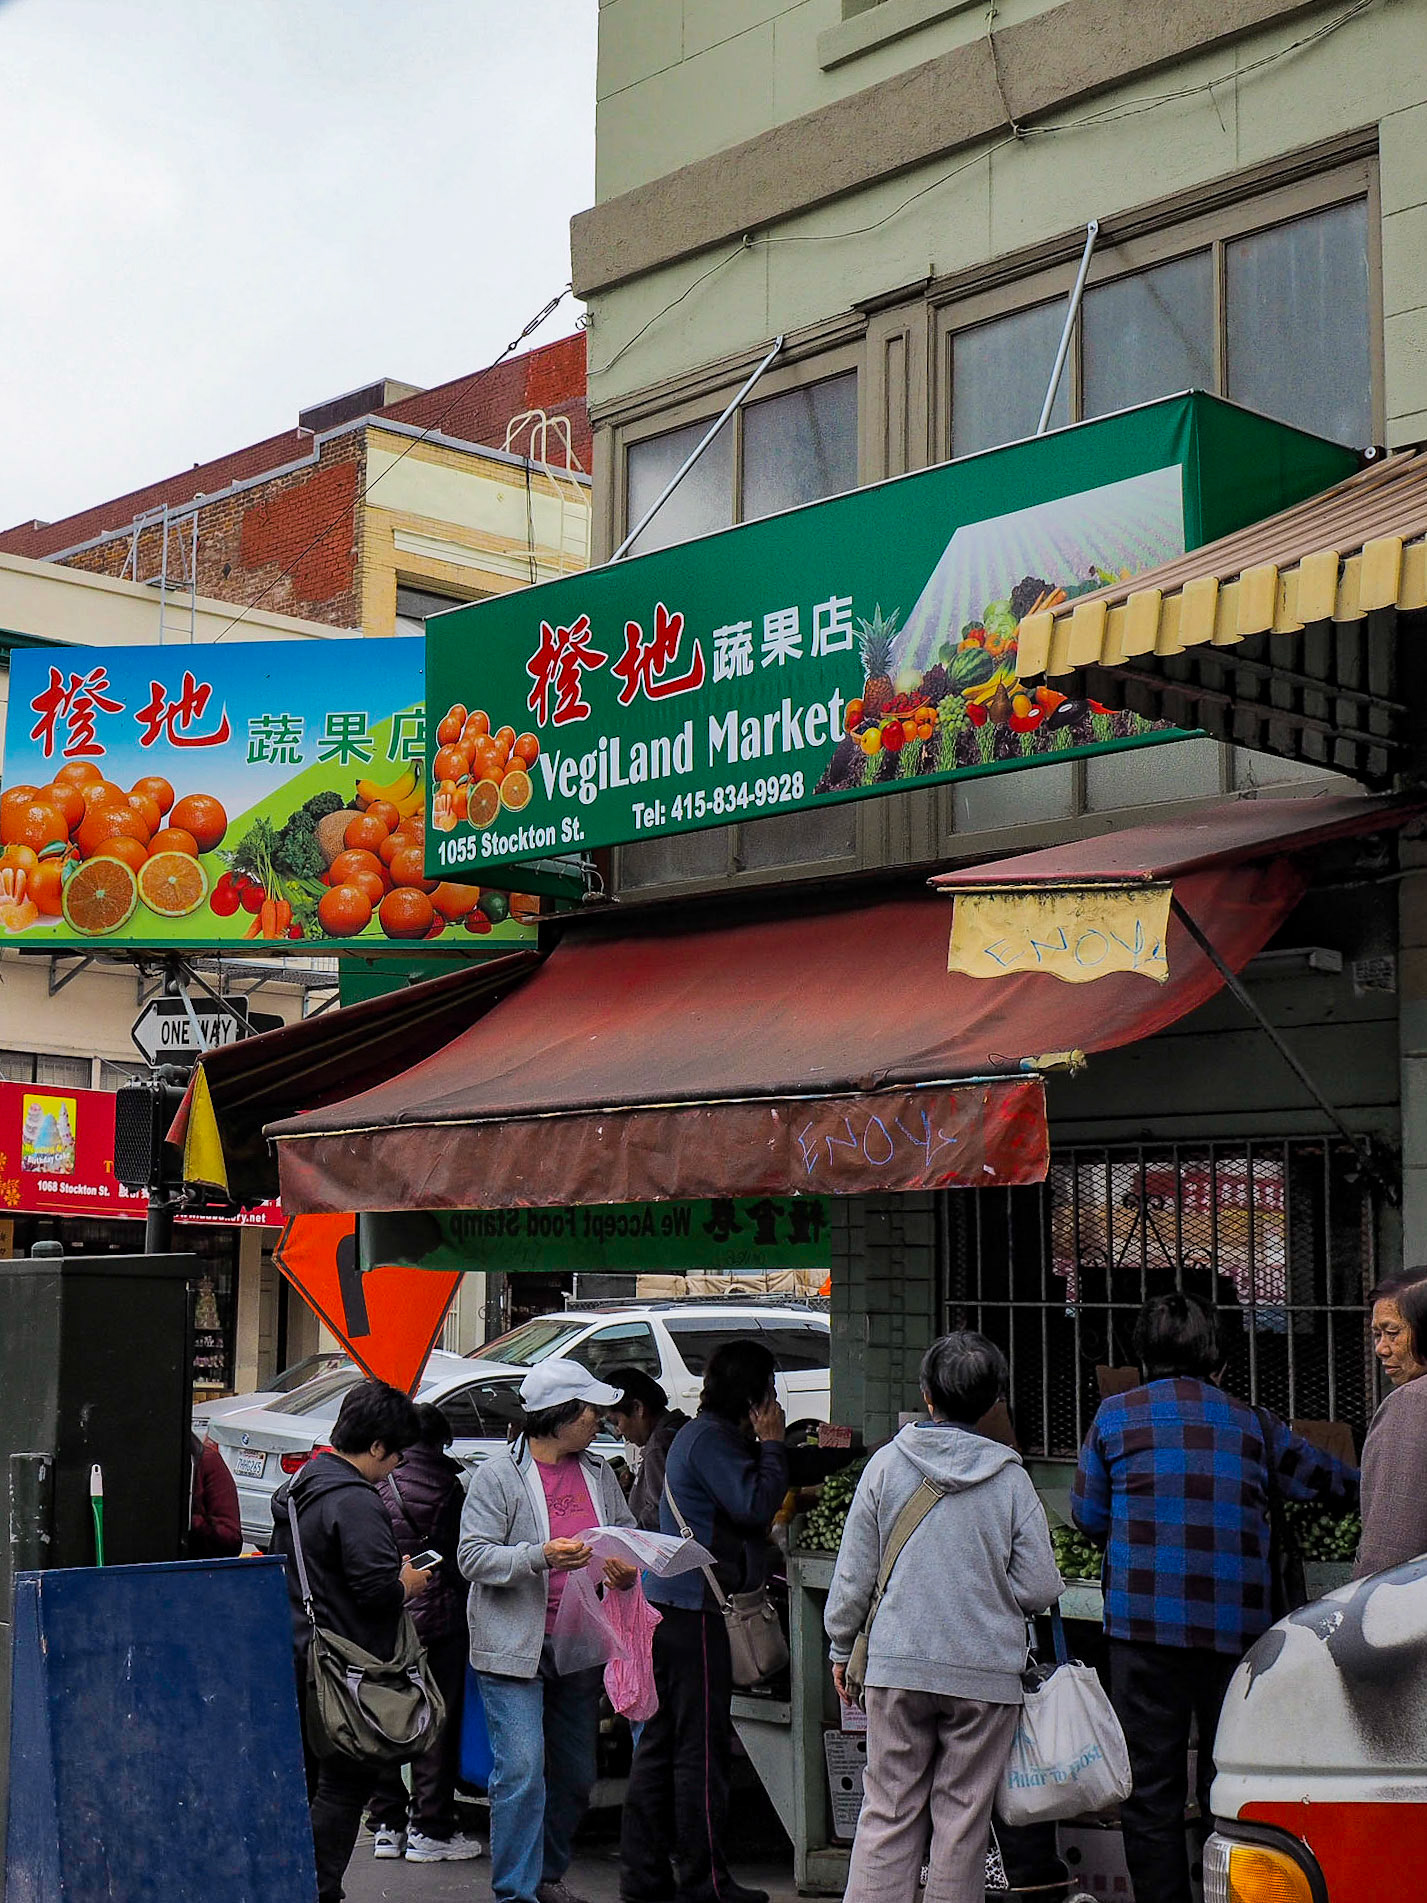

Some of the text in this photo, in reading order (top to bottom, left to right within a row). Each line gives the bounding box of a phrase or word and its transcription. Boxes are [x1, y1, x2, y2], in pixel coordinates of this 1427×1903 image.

[526, 595, 853, 728] 橙地 蔬果店
[31, 665, 230, 758] 橙地
[539, 687, 846, 804] VegiLand Market
[632, 770, 805, 830] Tel: 415-834-9928
[438, 816, 585, 866] 1055 Stockton St.
[161, 1020, 190, 1045] ONE
[37, 1180, 58, 1193] 1068
[59, 1182, 97, 1196] Stockton
[98, 1184, 110, 1197] St.
